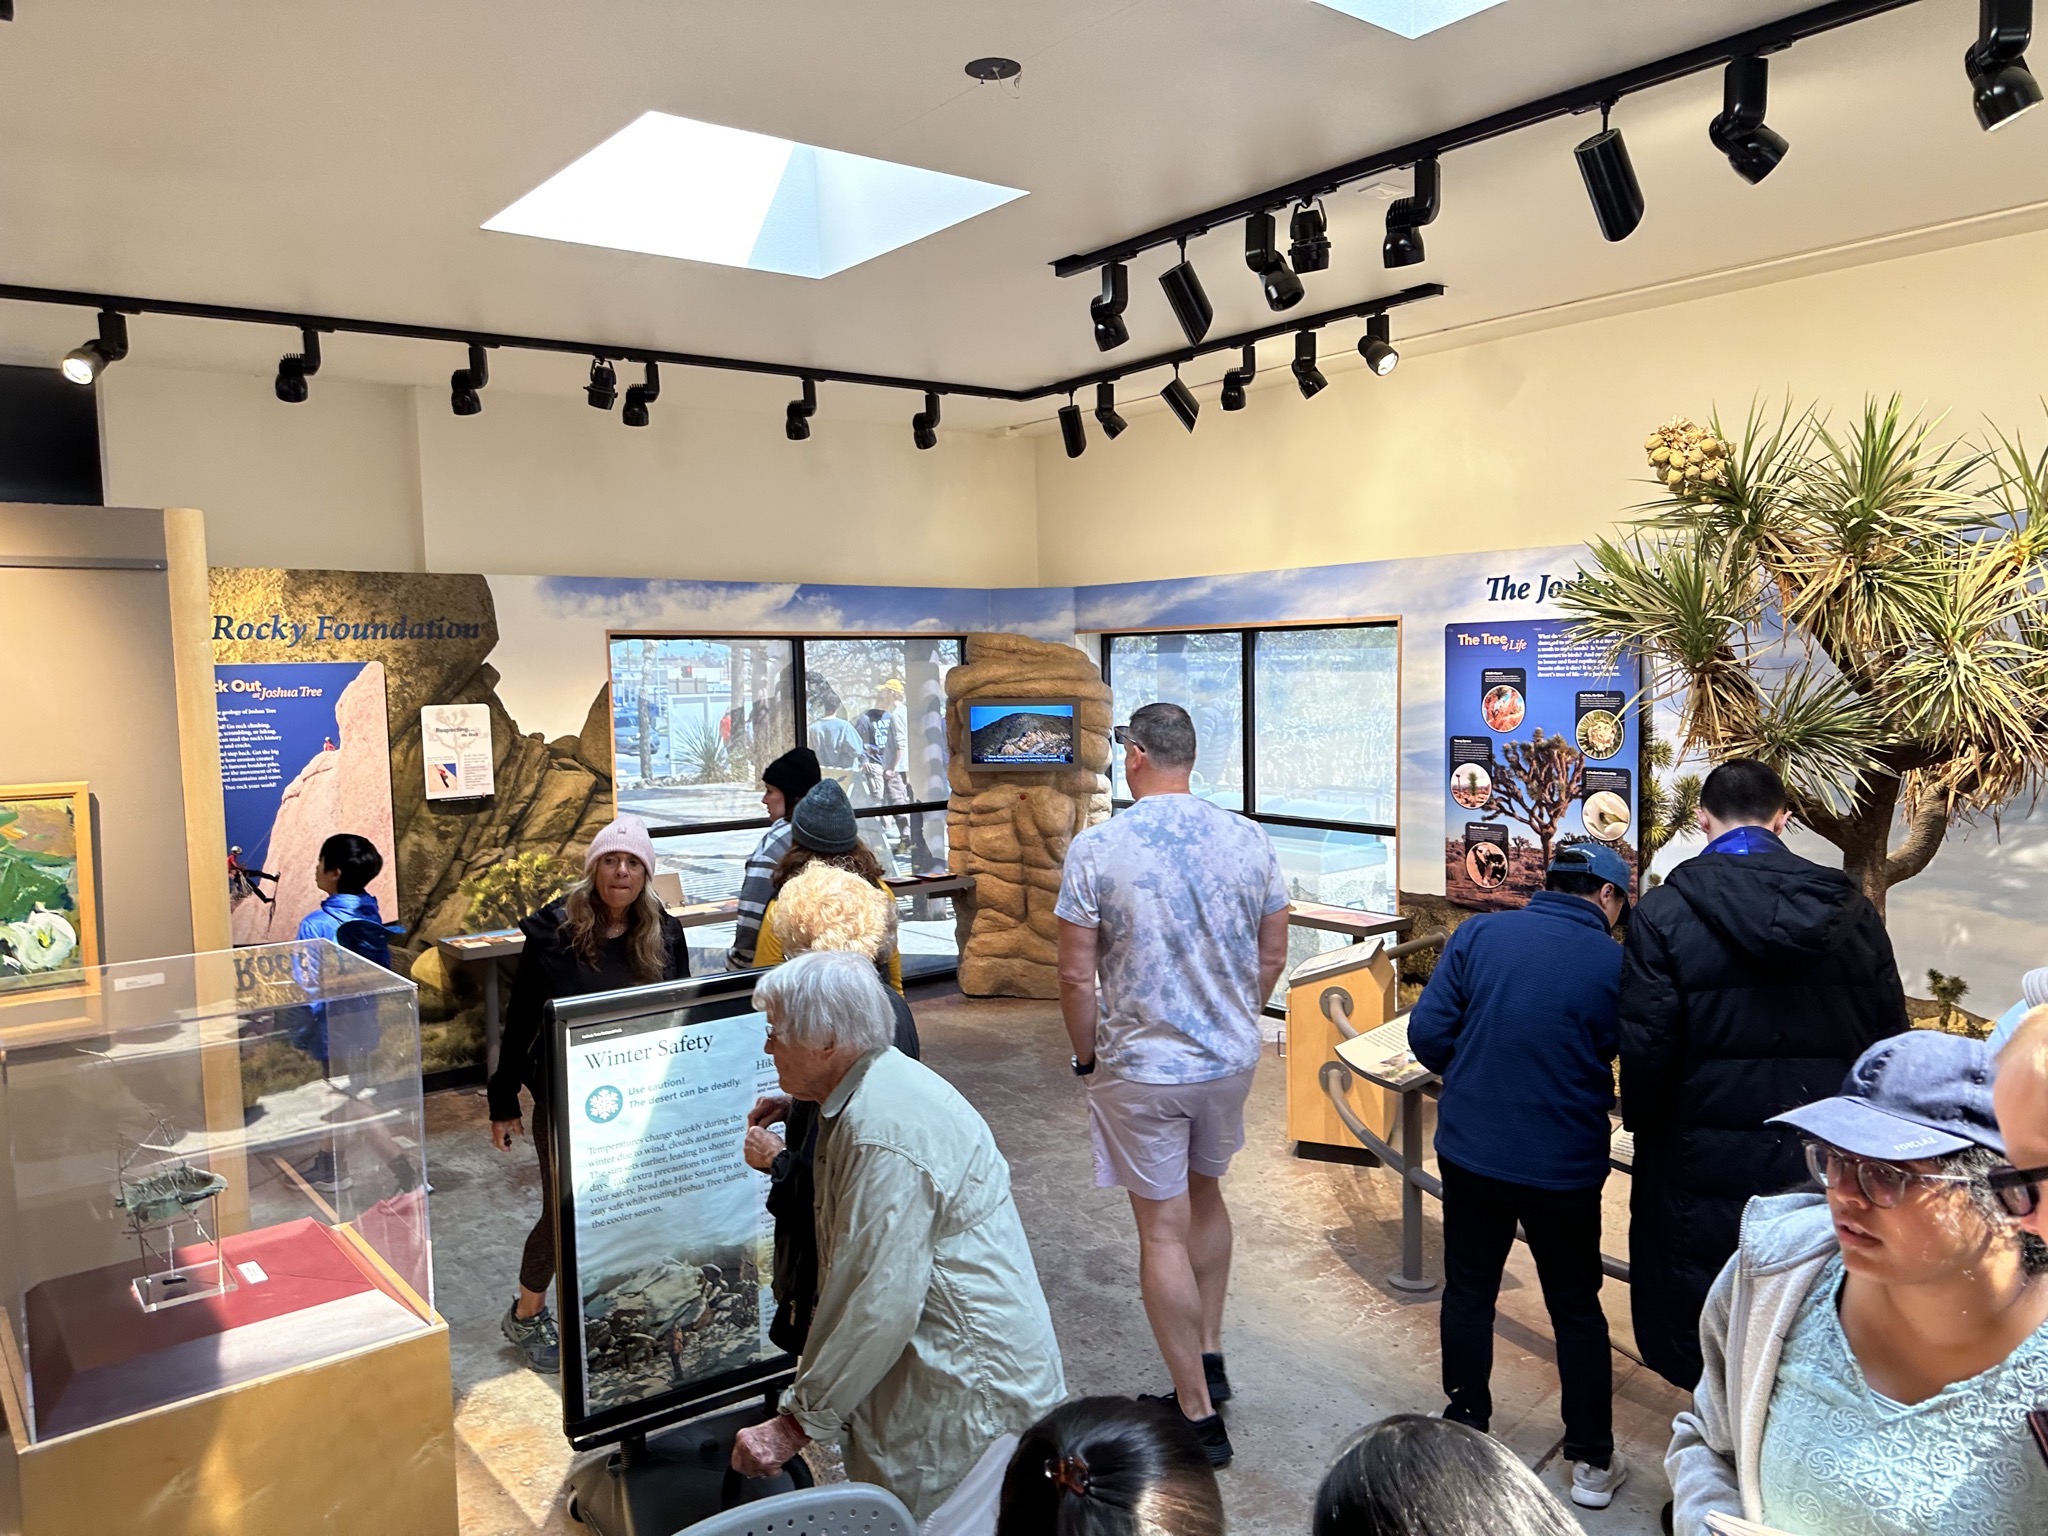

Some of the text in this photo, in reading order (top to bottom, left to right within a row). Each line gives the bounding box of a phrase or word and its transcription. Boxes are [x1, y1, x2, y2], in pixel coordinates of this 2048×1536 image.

[1486, 574, 1531, 602] The
[212, 614, 480, 648] Rocky Foundation
[1457, 632, 1508, 646] The Tree
[1501, 638, 1527, 653] of Life
[214, 679, 262, 693] ck Out
[259, 686, 298, 701] Joshua
[299, 686, 323, 697] Tree
[585, 1034, 714, 1070] Winter Safety
[756, 1058, 775, 1070] Hik
[628, 1076, 686, 1096] Use caution!
[628, 1078, 742, 1109] The desert can be deadly.
[588, 1114, 743, 1156] Temperatures change quickly during the
[588, 1125, 746, 1168] winter due to wind, clouds and moisture.
[588, 1138, 736, 1180] The sun sets earlier, leading to shorter
[589, 1151, 736, 1193] days. Take extra precautions to ensure
[589, 1160, 742, 1207] your safety. Read the Hike Smart tips to
[590, 1171, 749, 1218] stay safe while visiting Joshua Tree during
[591, 1206, 664, 1230] the cooler season.
